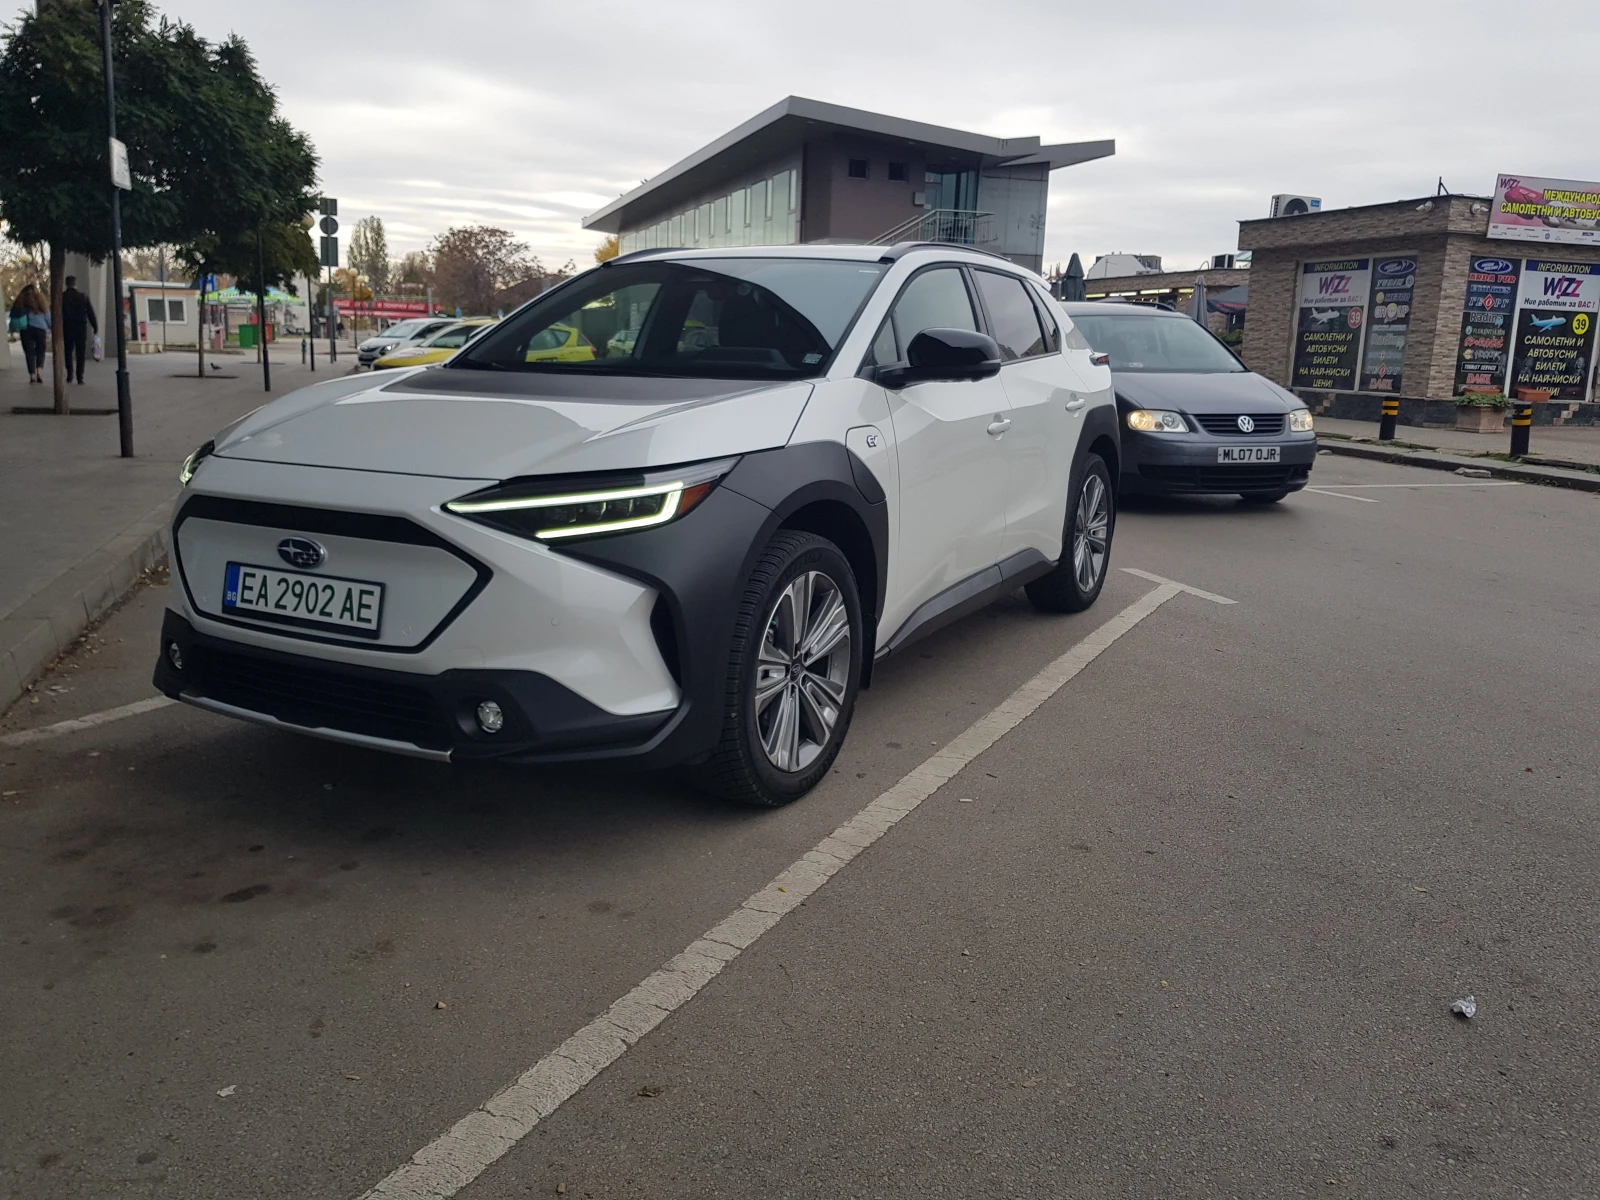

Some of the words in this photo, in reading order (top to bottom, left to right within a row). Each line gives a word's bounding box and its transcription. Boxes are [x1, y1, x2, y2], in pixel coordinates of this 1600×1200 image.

[1500, 202, 1554, 216] САМОЛЕТНИ
[1555, 206, 1562, 217] И
[1314, 261, 1359, 271] INFORMATION
[1537, 262, 1591, 274] INFORMATION
[1469, 273, 1496, 282] ARDA
[1524, 297, 1536, 305] Ние
[1537, 298, 1567, 308] работим
[1350, 311, 1361, 324] 39
[1574, 318, 1586, 330] 39
[1303, 333, 1346, 341] САМОЛЕТНИ
[1346, 333, 1353, 341] И
[1524, 335, 1576, 346] САМОЛЕТНИ
[1576, 338, 1585, 347] И
[1306, 345, 1348, 353] АВТОБУСНИ
[1527, 348, 1578, 359] АВТОБУСНИ
[1312, 356, 1339, 365] БИЛЕТИ
[1535, 361, 1567, 371] БИЛЕТИ
[1300, 367, 1309, 375] НА
[1312, 379, 1334, 388] ЦЕНИ!
[1517, 373, 1530, 383] НА
[1531, 374, 1581, 384] НАЙ-НИСКИ
[1222, 448, 1254, 461] ML07
[227, 591, 237, 601] BG
[240, 572, 269, 608] EA
[274, 577, 336, 618] 2902
[339, 587, 375, 624] AE
